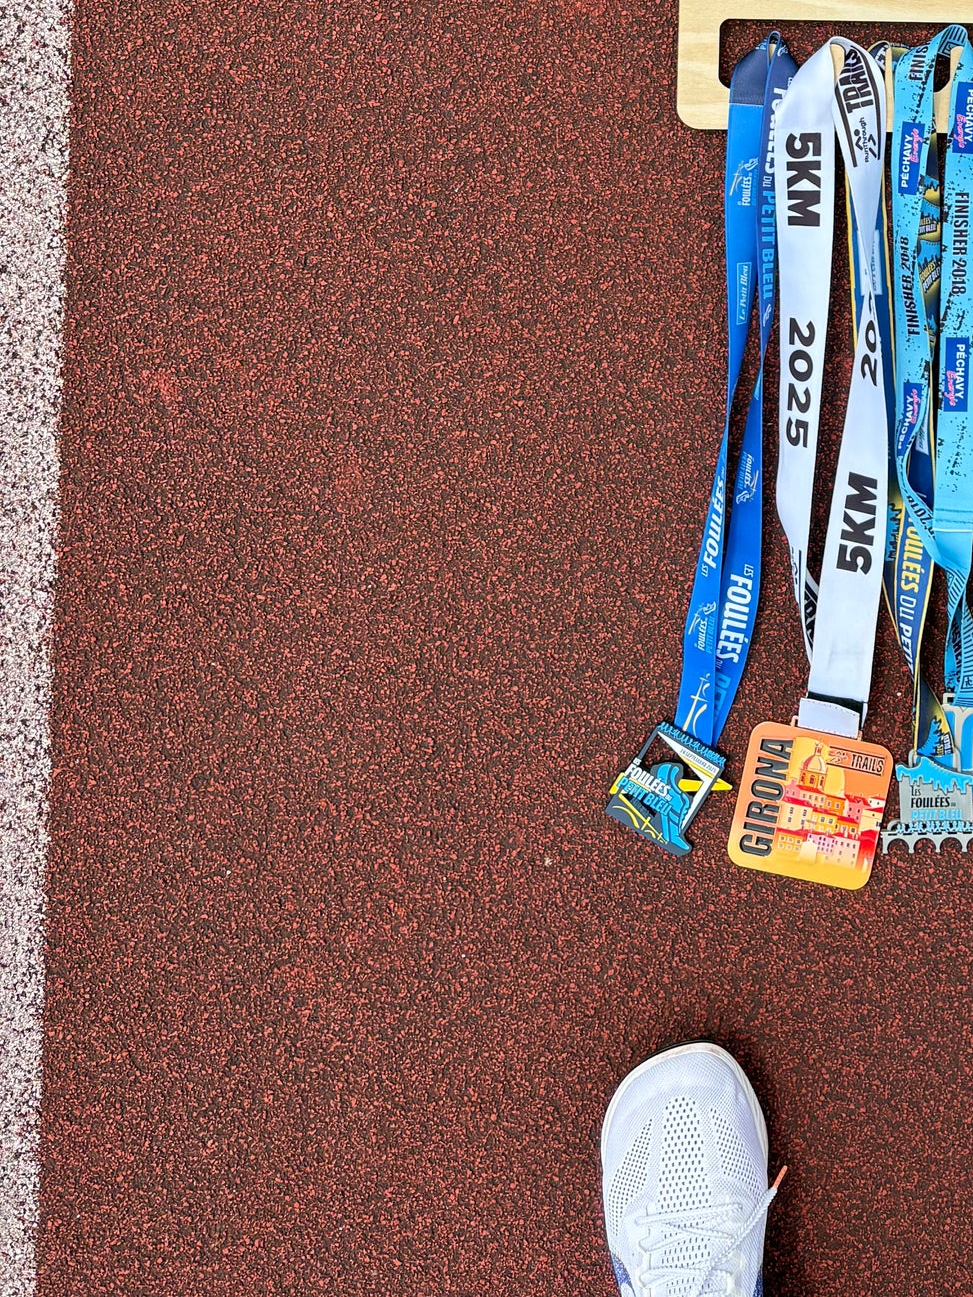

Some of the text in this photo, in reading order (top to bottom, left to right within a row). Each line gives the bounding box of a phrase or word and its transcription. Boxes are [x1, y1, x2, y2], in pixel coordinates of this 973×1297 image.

[785, 132, 822, 227] 5KM
[901, 135, 913, 188] PÉCHAVY
[761, 190, 776, 244] PETIT
[952, 192, 969, 295] FINISHER 2018
[740, 264, 749, 286] Bleu
[762, 251, 775, 300] BLEU
[901, 273, 920, 336] FINISHER
[786, 317, 816, 449] 2025
[955, 343, 966, 399] PÉCHAVY
[703, 476, 725, 569] FOULÉES
[836, 472, 878, 575] 5KM
[744, 564, 754, 577] LES
[716, 574, 752, 663] FOULÉES
[900, 595, 917, 621] DU
[697, 619, 708, 651] FOULÉES
[625, 765, 670, 798] FOULÉES
[851, 753, 884, 774] TRAILS
[618, 776, 673, 816] PETIT BLEU
[739, 738, 794, 857] GIRONA
[911, 787, 921, 796] LES
[911, 795, 950, 808] FOULÉES
[911, 809, 962, 821] PETIT BLEU
